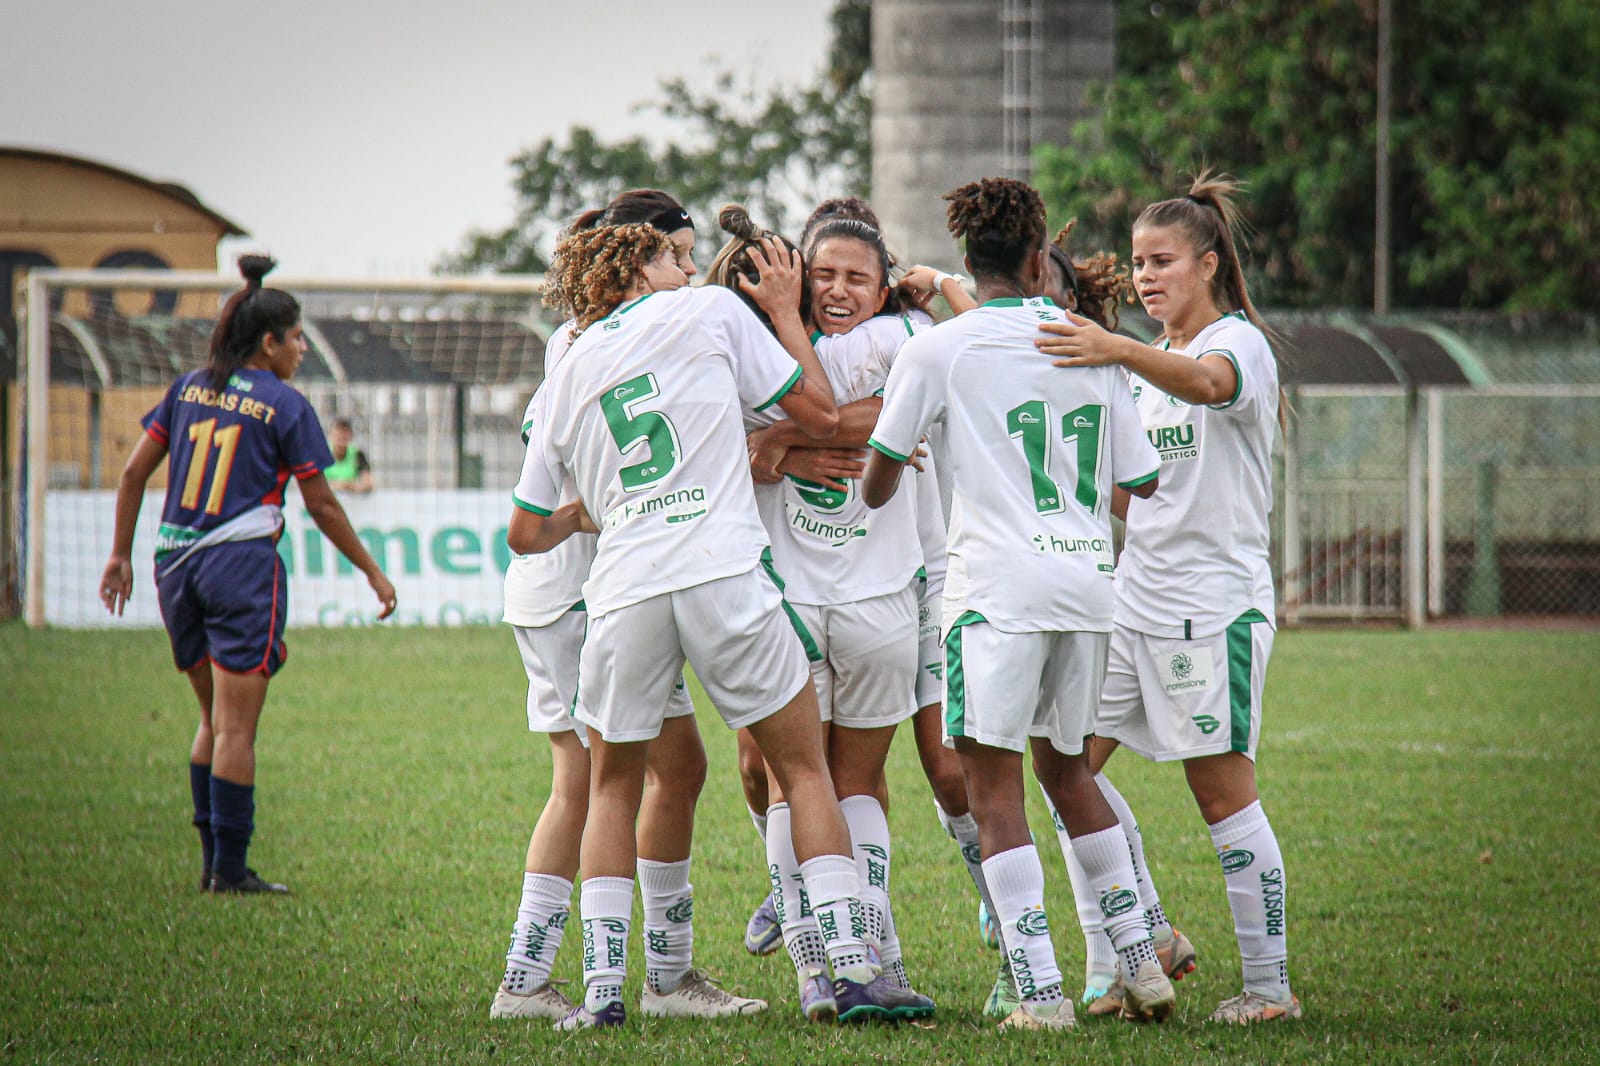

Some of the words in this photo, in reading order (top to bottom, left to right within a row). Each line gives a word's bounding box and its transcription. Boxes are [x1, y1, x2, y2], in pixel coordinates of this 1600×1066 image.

[239, 396, 276, 424] BET
[600, 372, 682, 493] 5
[181, 418, 243, 515] 11
[1007, 400, 1107, 520] 11
[768, 863, 788, 925] PROSOCKS
[1259, 867, 1284, 936] PROSOCKS
